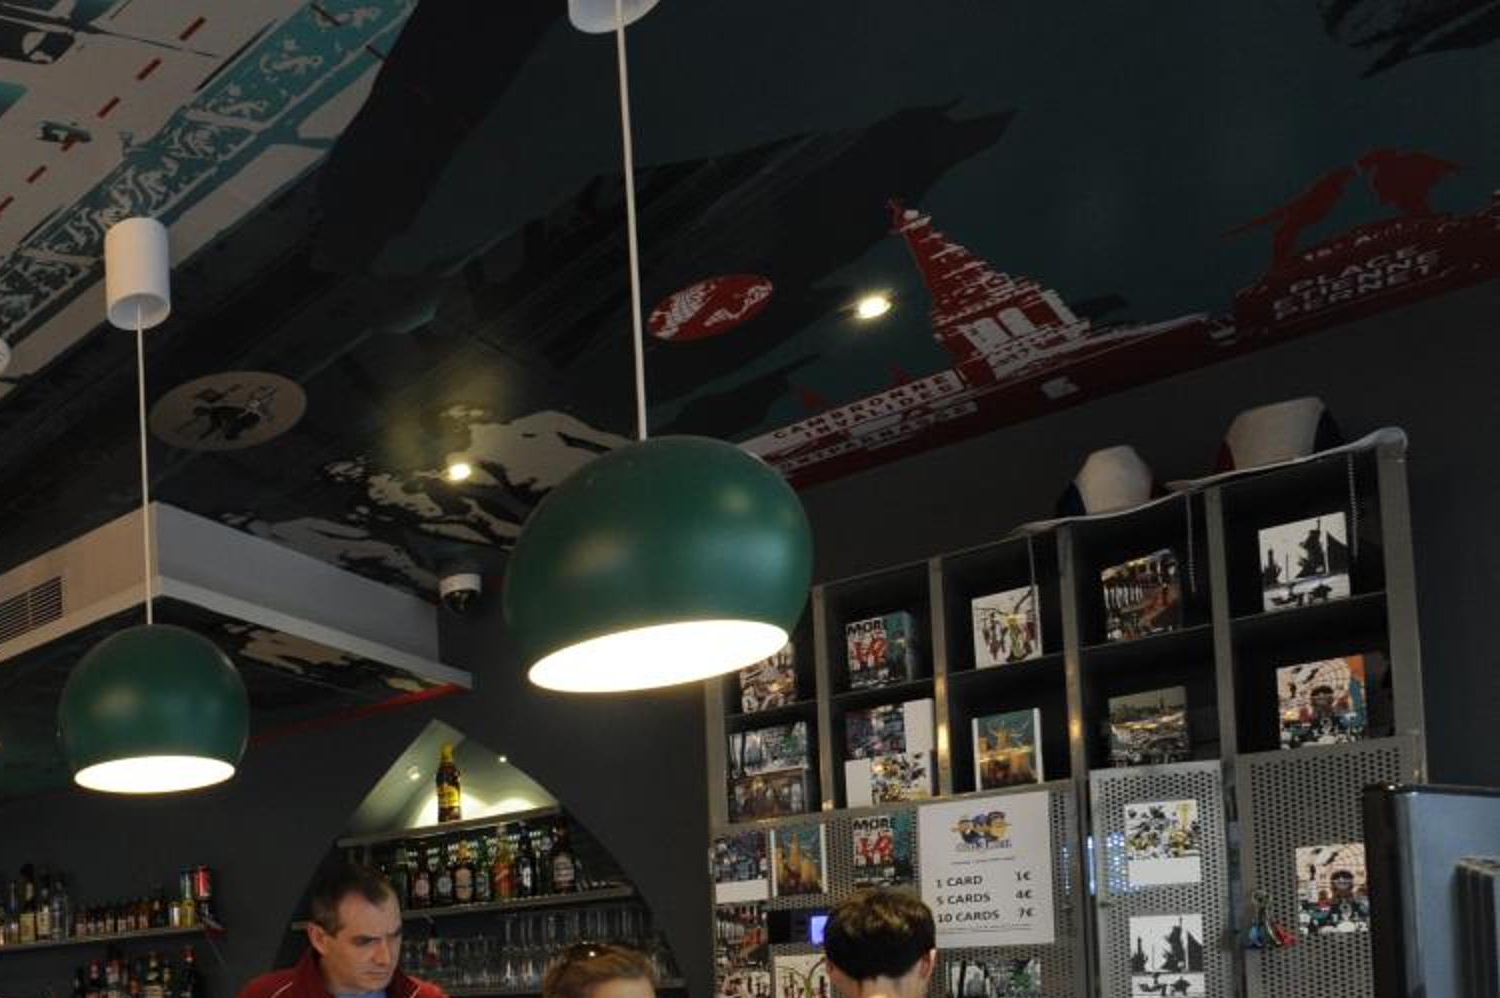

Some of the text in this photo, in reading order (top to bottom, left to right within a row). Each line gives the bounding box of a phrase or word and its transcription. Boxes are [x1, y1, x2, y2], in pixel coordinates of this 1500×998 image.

[946, 874, 983, 887] CARD
[947, 893, 991, 905] CARDS
[937, 912, 953, 923] 10
[955, 909, 1000, 922] CARDS
